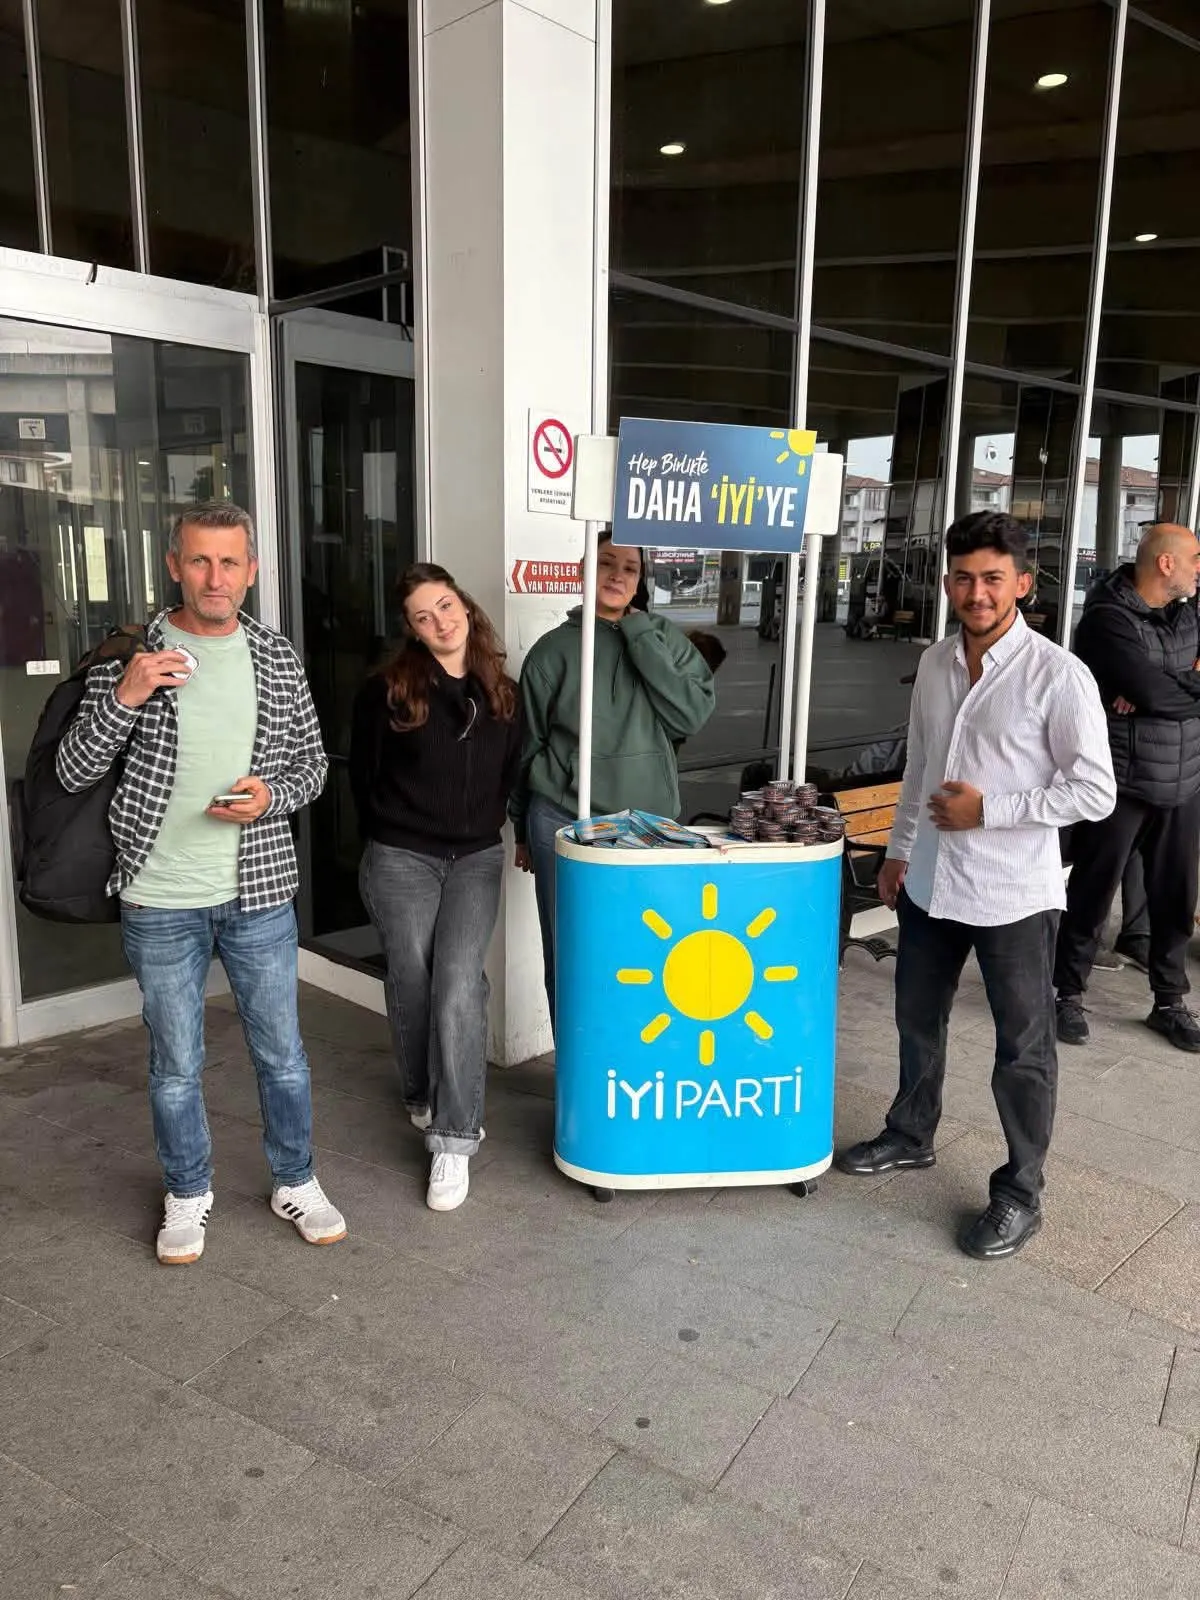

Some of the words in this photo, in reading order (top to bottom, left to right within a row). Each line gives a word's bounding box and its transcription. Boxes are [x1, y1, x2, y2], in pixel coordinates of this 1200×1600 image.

[628, 452, 657, 475] Hep
[627, 477, 701, 523] DAHA
[528, 580, 542, 593] YAN
[545, 581, 582, 593] TARAFTAN
[607, 1068, 665, 1121] İYİ
[675, 1065, 802, 1121] PARTİ
